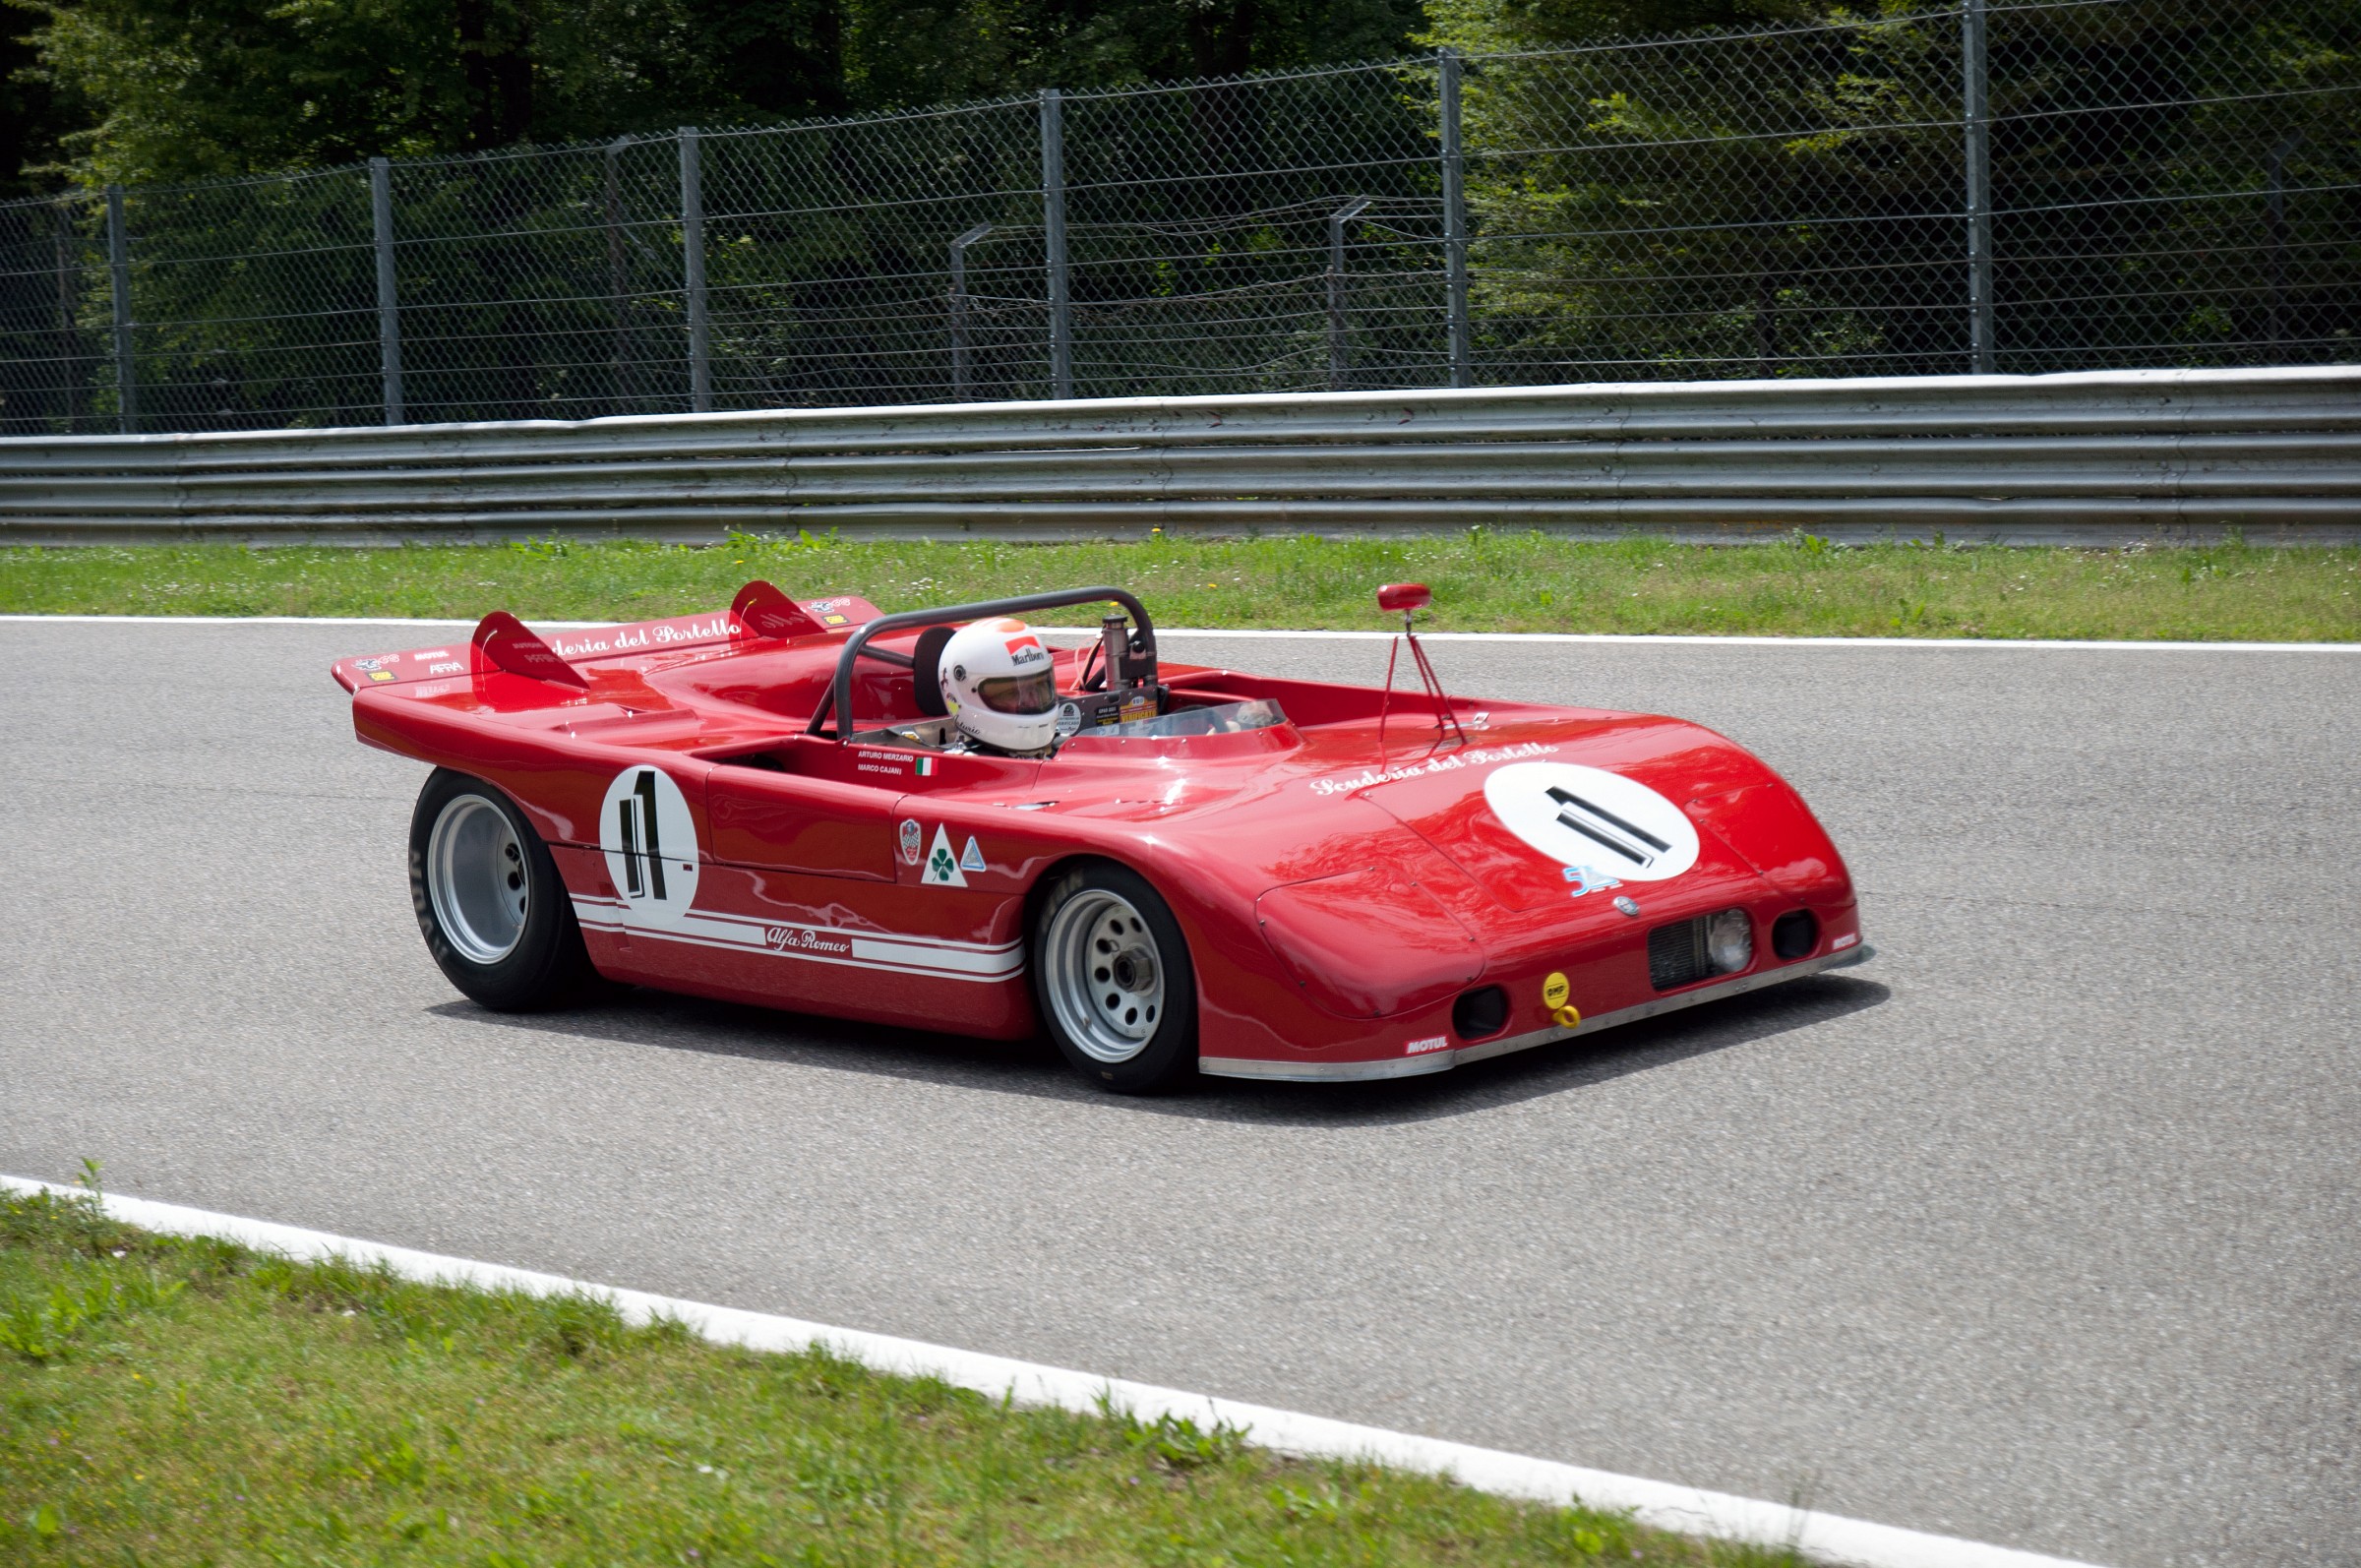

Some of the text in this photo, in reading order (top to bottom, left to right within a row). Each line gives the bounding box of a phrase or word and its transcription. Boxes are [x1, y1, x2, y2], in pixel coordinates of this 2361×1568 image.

[551, 619, 742, 657] deria del Portello
[414, 650, 450, 660] MOTUL
[858, 751, 914, 762] ARTURO MERZARIO
[858, 763, 902, 775] MARCO CAJANI
[1309, 742, 1559, 796] Scuderia del Portello
[766, 927, 850, 952] Alfa Romeo
[1547, 986, 1565, 996] OMP
[1407, 1036, 1448, 1054] MOTUL
